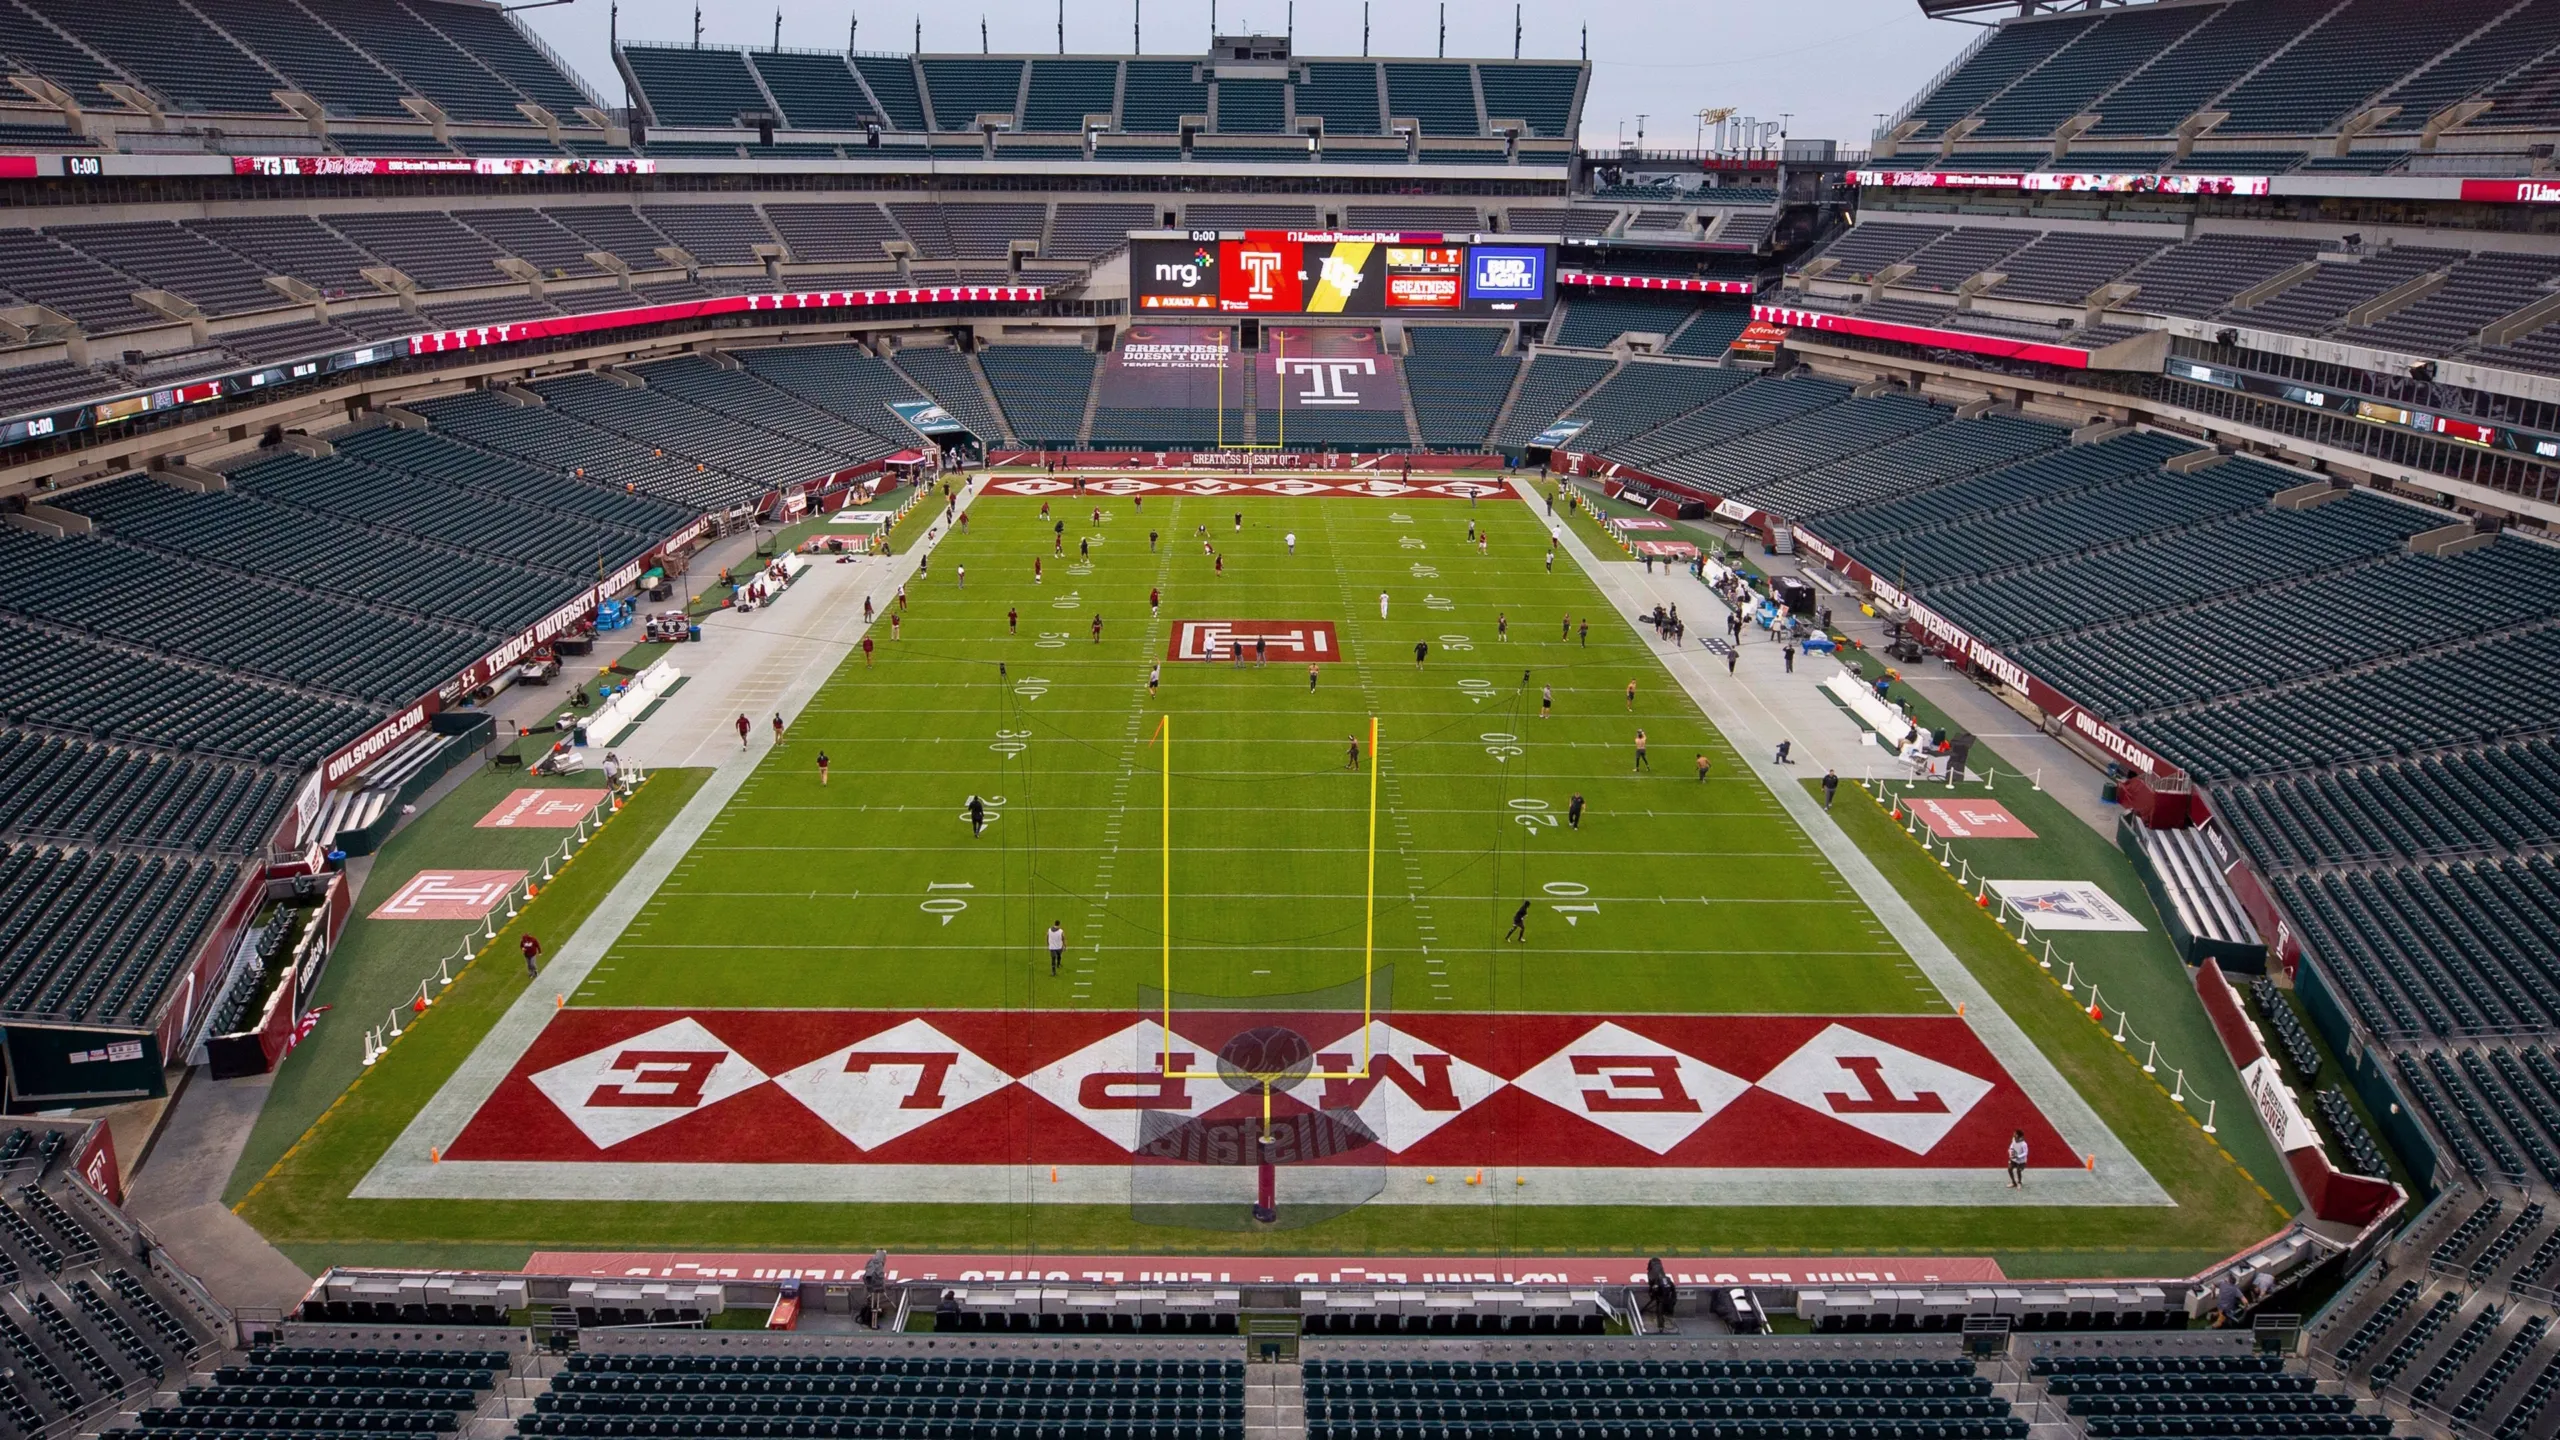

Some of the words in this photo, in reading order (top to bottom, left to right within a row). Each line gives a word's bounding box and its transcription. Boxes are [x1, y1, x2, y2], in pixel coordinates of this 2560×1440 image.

[1700, 106, 1737, 125] Miller
[1711, 116, 1780, 157] Lite
[71, 158, 98, 175] 0:00
[253, 157, 281, 175] #73
[283, 159, 300, 175] DL
[1192, 231, 1215, 241] 0:00
[1298, 232, 1333, 242] Lincoln
[1334, 232, 1375, 242] Financial
[1376, 232, 1400, 242] Field
[1240, 251, 1281, 300] T
[1487, 260, 1525, 273] BUD
[1392, 280, 1455, 294] GREATNESS
[1748, 326, 1786, 337] xfinity
[1123, 352, 1188, 360] DOESN'T
[1190, 353, 1229, 361] QUIT.
[1124, 344, 1229, 353] GREATNESS
[1276, 357, 1376, 404] T
[2304, 391, 2324, 406] 0:00
[28, 417, 54, 437] 0:00
[1243, 454, 1279, 465] DESN'T
[1567, 452, 1583, 474] T
[486, 633, 535, 676] TEMPLE
[536, 590, 597, 642] UNIVERSITY
[597, 560, 642, 600] FOOTBALL
[1034, 632, 1070, 648] 50
[1439, 635, 1475, 651] 50
[1870, 574, 1907, 609] TEMPLE
[1970, 641, 2030, 696] FOOTBALL
[1014, 676, 1051, 694] 40
[1457, 679, 1497, 698] 40
[328, 705, 424, 782] OWLSPORTS.COM
[989, 730, 1033, 751] 30
[1480, 733, 1523, 756] 30
[2075, 711, 2155, 771] OWLSTIX.COM
[1508, 799, 1559, 827] 20
[920, 881, 975, 913] 10
[1542, 881, 1600, 915] 10
